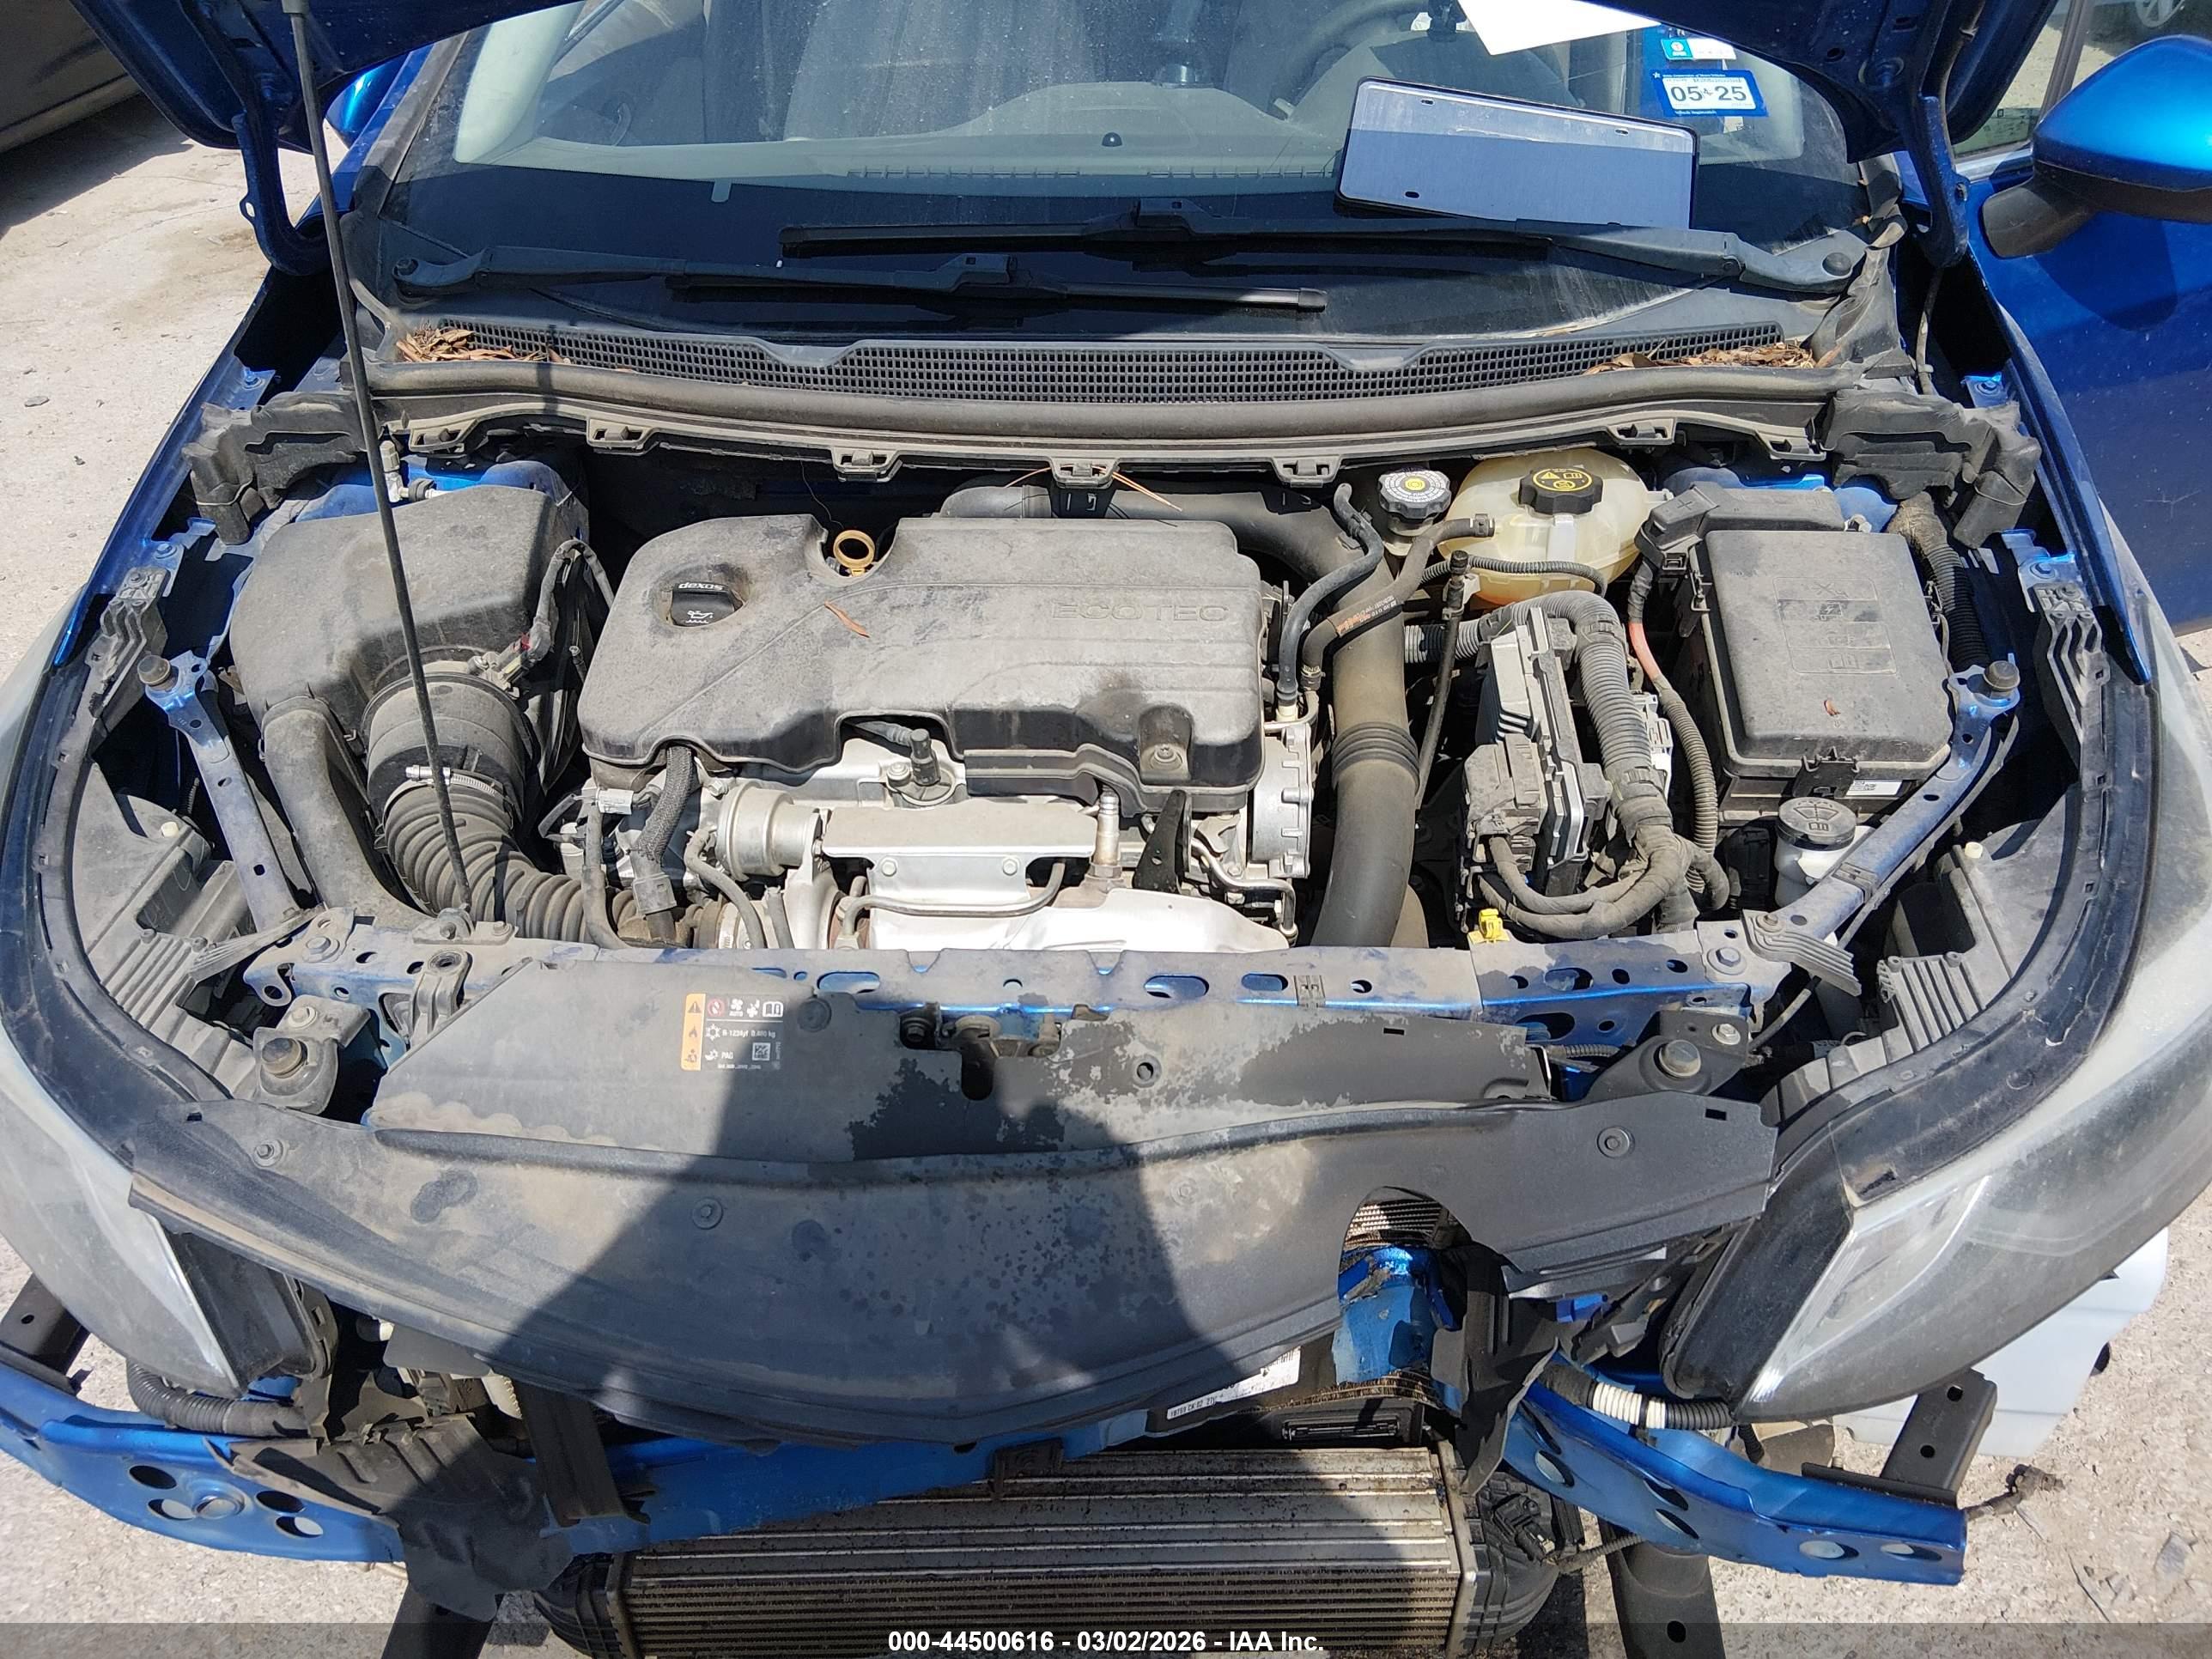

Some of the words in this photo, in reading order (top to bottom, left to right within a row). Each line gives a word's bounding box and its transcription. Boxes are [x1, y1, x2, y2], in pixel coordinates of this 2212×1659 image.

[1670, 86, 1703, 101] 05
[1714, 86, 1747, 100] 25
[678, 582, 723, 591] dexos
[1052, 604, 1230, 622] ECOTEC
